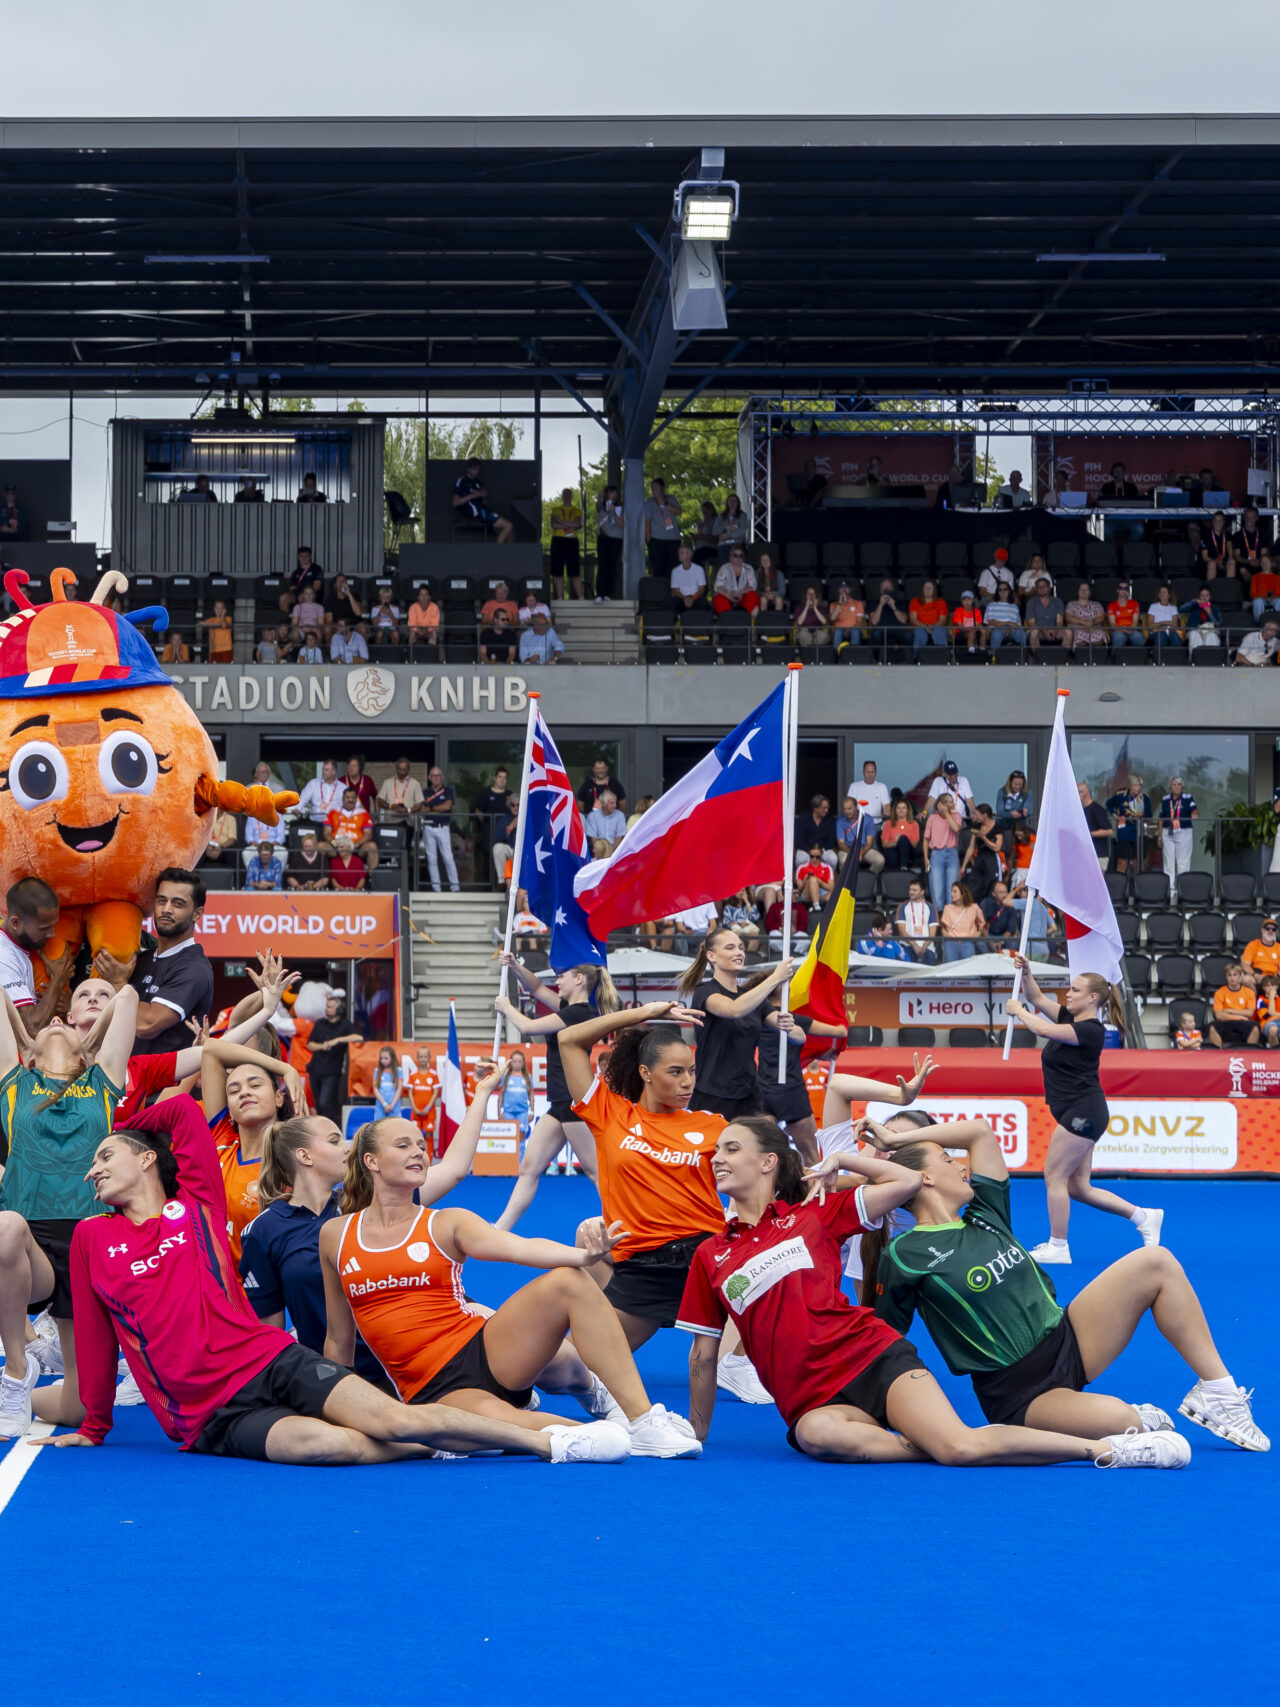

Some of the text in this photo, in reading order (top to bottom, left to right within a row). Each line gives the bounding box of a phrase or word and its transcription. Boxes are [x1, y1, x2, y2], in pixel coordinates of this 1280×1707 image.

[888, 474, 929, 483] WORLD
[410, 675, 527, 712] KNHB
[230, 914, 324, 935] WORLD
[330, 914, 377, 935] CUP
[929, 1002, 1030, 1014] Hero VIA
[1106, 1115, 1205, 1137] ONVZ
[619, 1135, 702, 1167] Rabobank
[1093, 1143, 1139, 1153] ersteklas
[130, 1231, 187, 1276] SONY
[749, 1246, 805, 1278] RANMORE
[348, 1271, 431, 1298] Rabobank
